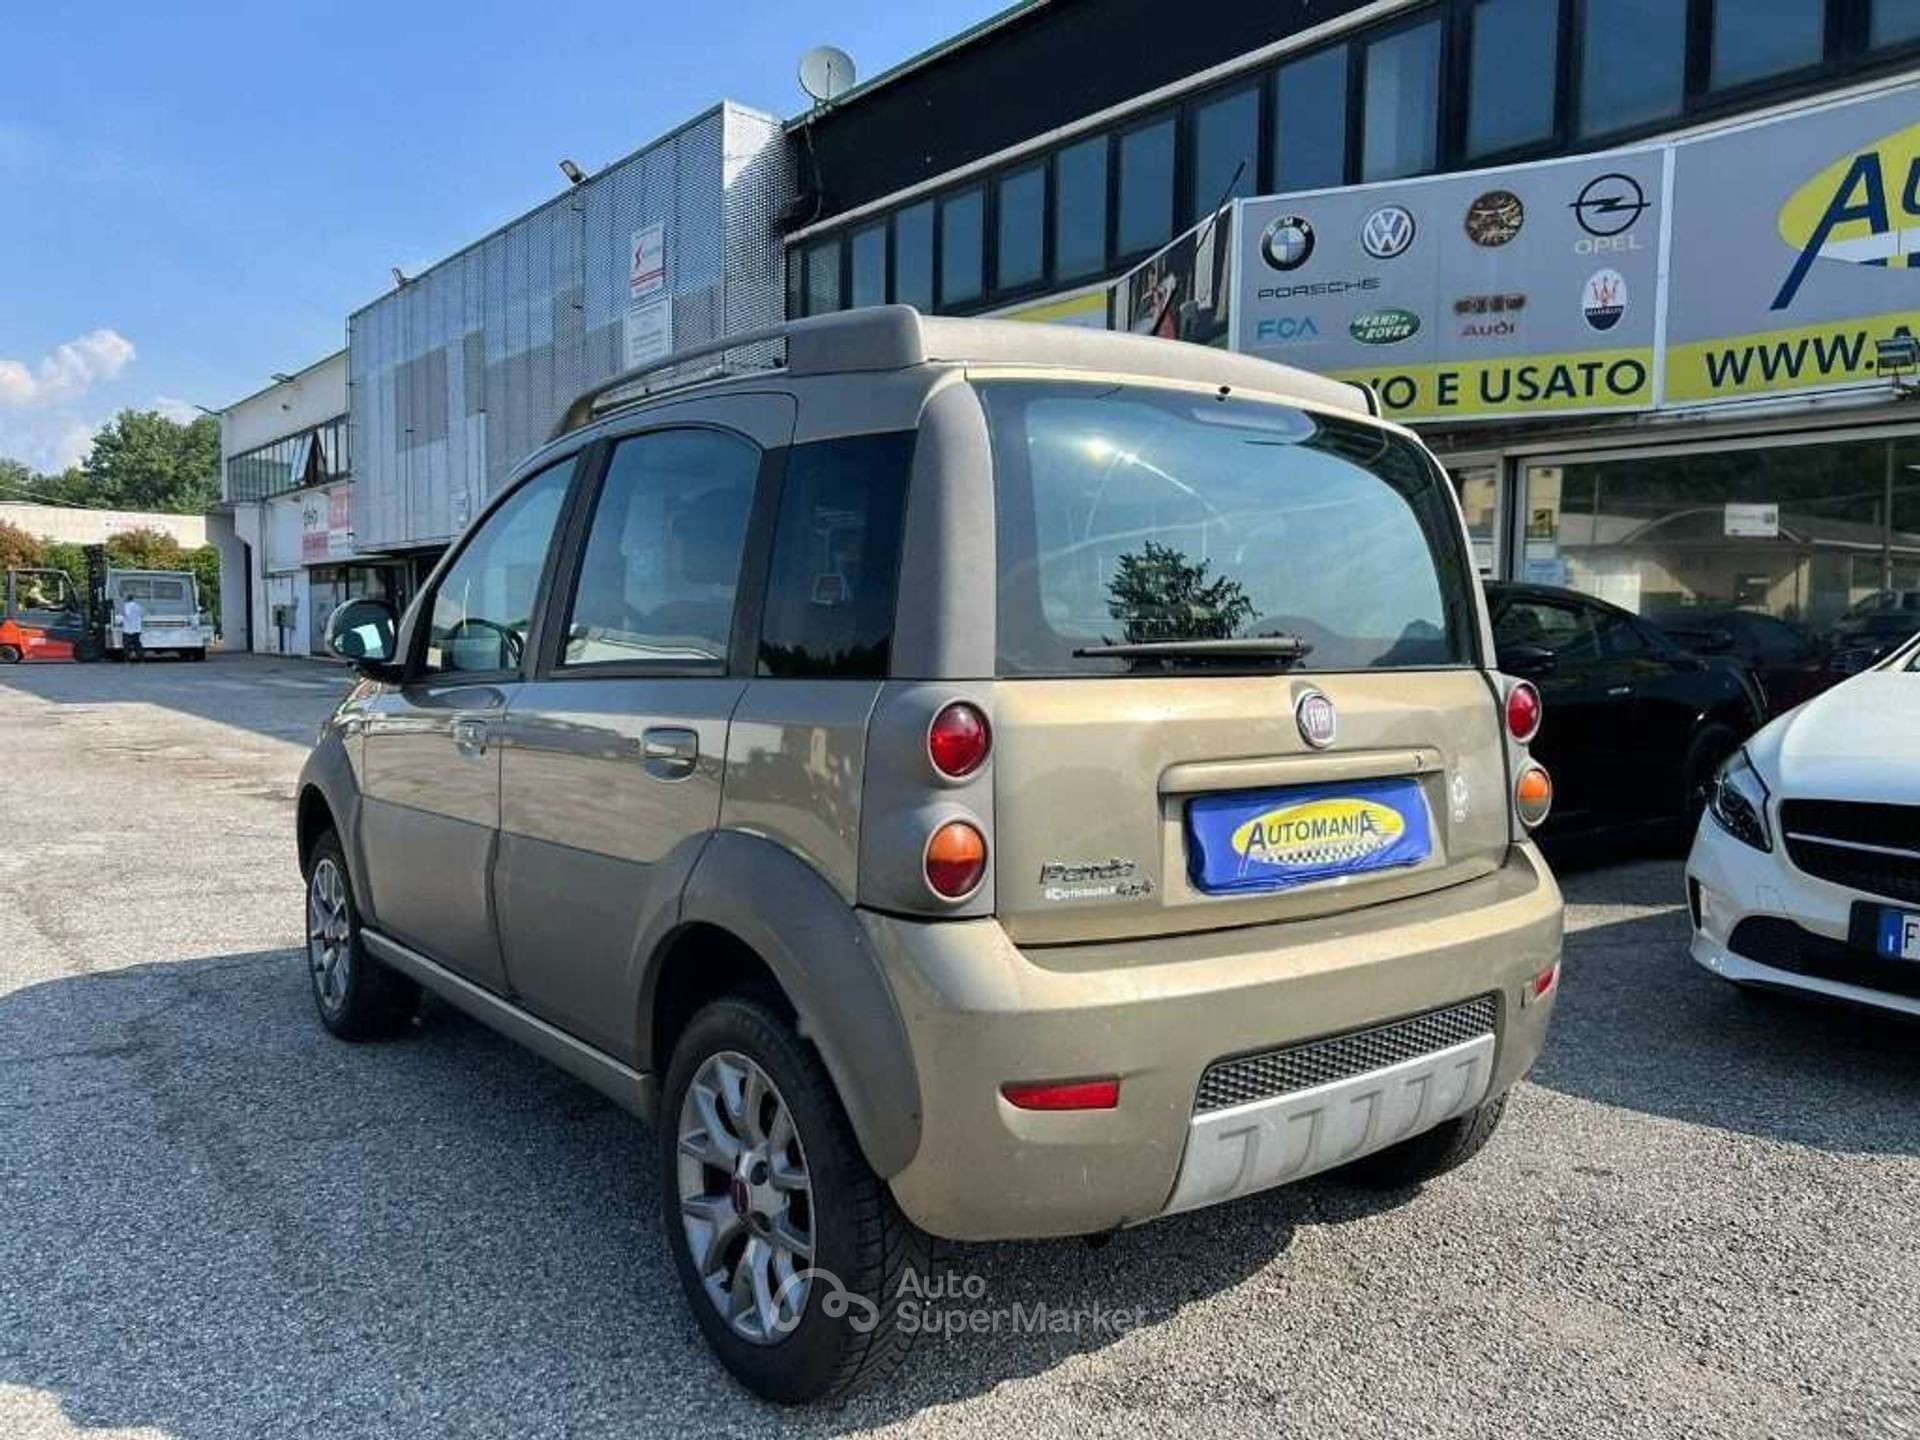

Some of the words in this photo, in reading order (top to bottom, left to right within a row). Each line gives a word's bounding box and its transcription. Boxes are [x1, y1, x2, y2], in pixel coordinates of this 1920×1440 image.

[1575, 238, 1643, 255] OPEL
[1258, 277, 1381, 300] PORSCHE
[1365, 325, 1412, 340] ROVER
[1438, 373, 1460, 406] E
[1480, 359, 1646, 402] USATO
[1240, 809, 1380, 864] AUTOMANIA
